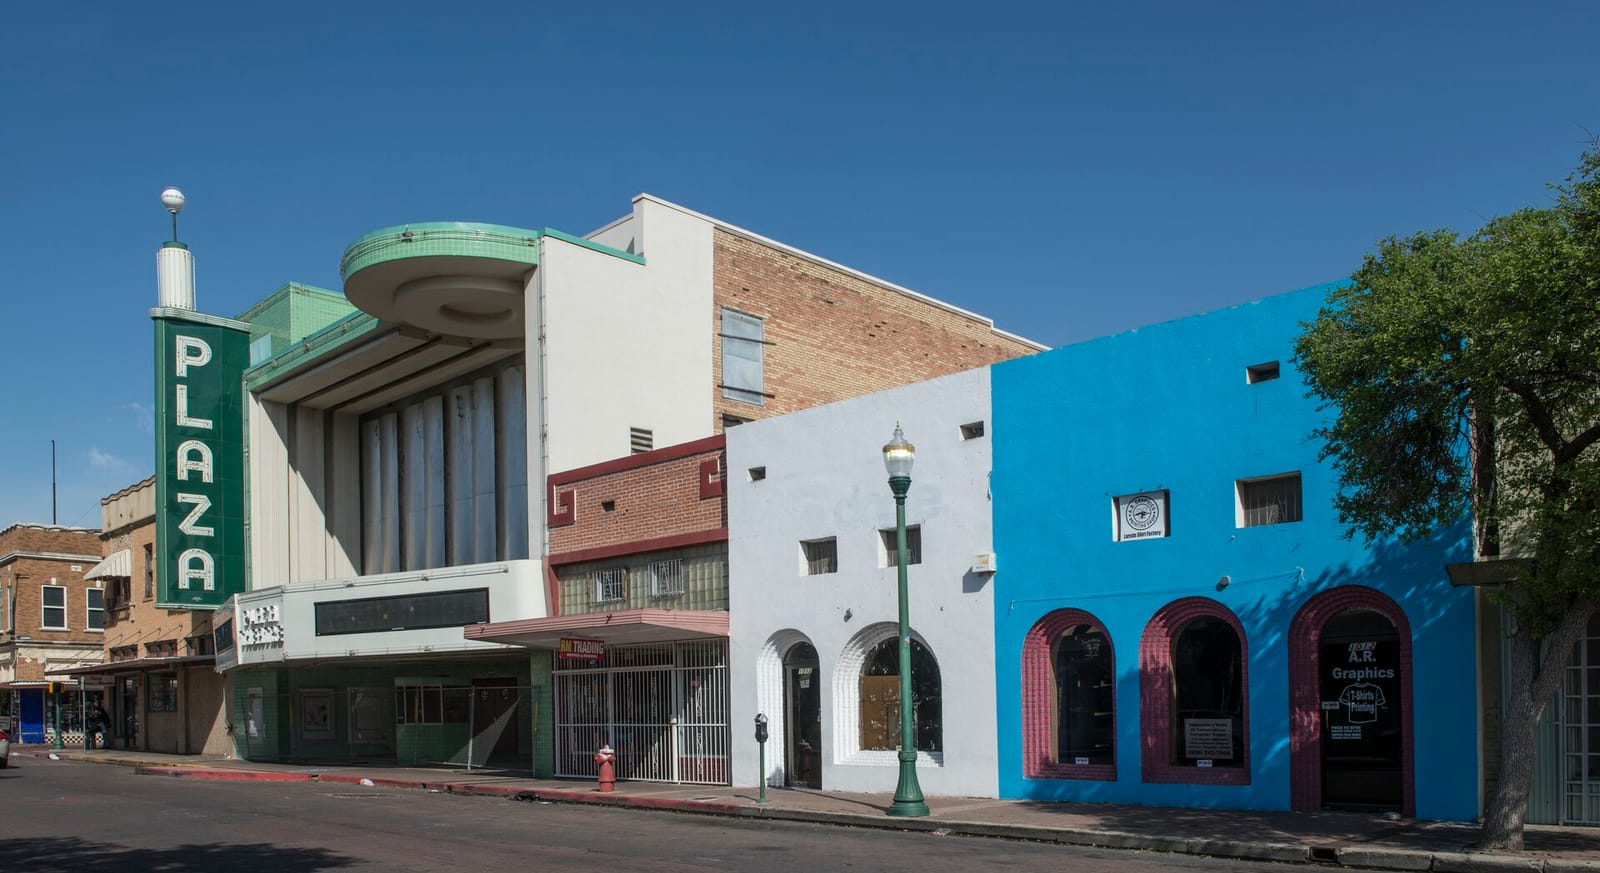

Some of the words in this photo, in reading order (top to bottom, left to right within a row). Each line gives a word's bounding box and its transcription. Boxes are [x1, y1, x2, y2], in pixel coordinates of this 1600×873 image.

[176, 334, 215, 591] PLAZA
[561, 640, 572, 652] RM
[573, 640, 604, 654] TRADING
[1348, 650, 1376, 662] A.R.
[1332, 667, 1395, 681] Graphics
[1351, 690, 1375, 700] T-Shirts
[1351, 702, 1375, 714] Printing
